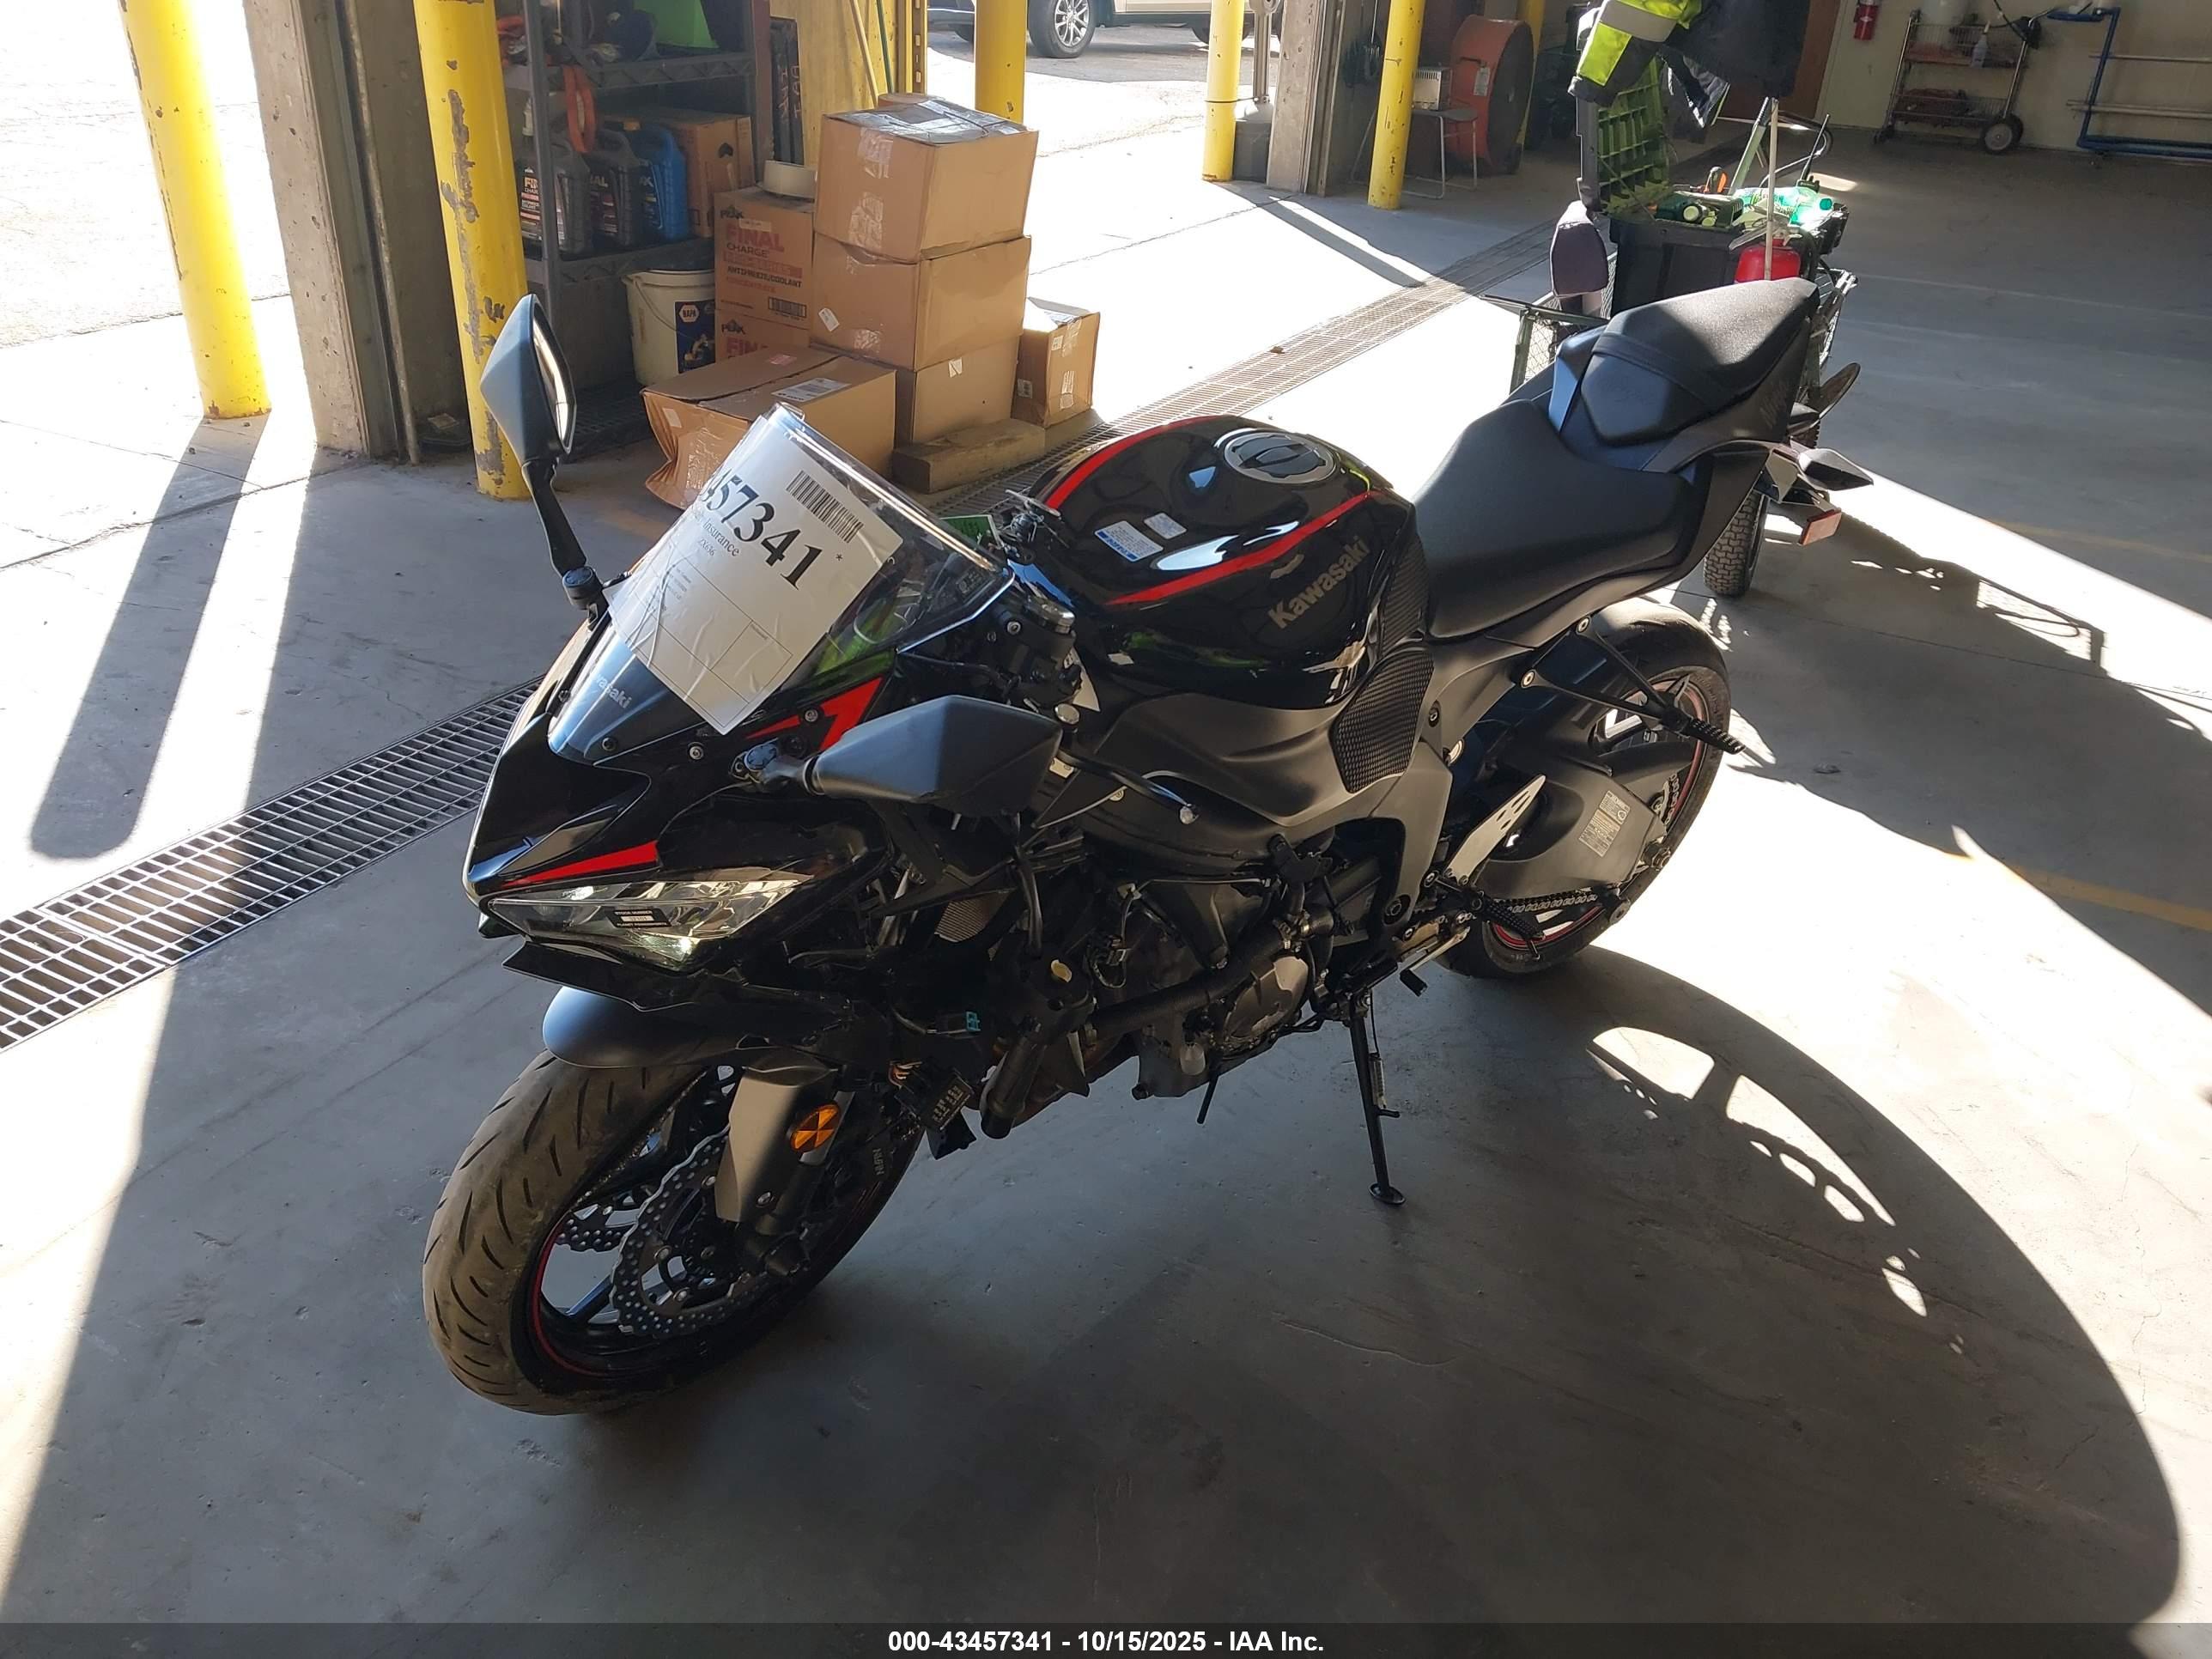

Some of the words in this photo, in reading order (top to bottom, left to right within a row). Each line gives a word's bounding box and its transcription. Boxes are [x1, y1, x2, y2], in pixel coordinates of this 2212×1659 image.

[726, 225, 785, 252] FINAL
[726, 243, 769, 258] CHARGE
[702, 520, 740, 557] Insurance
[1267, 535, 1370, 629] Kawasaki
